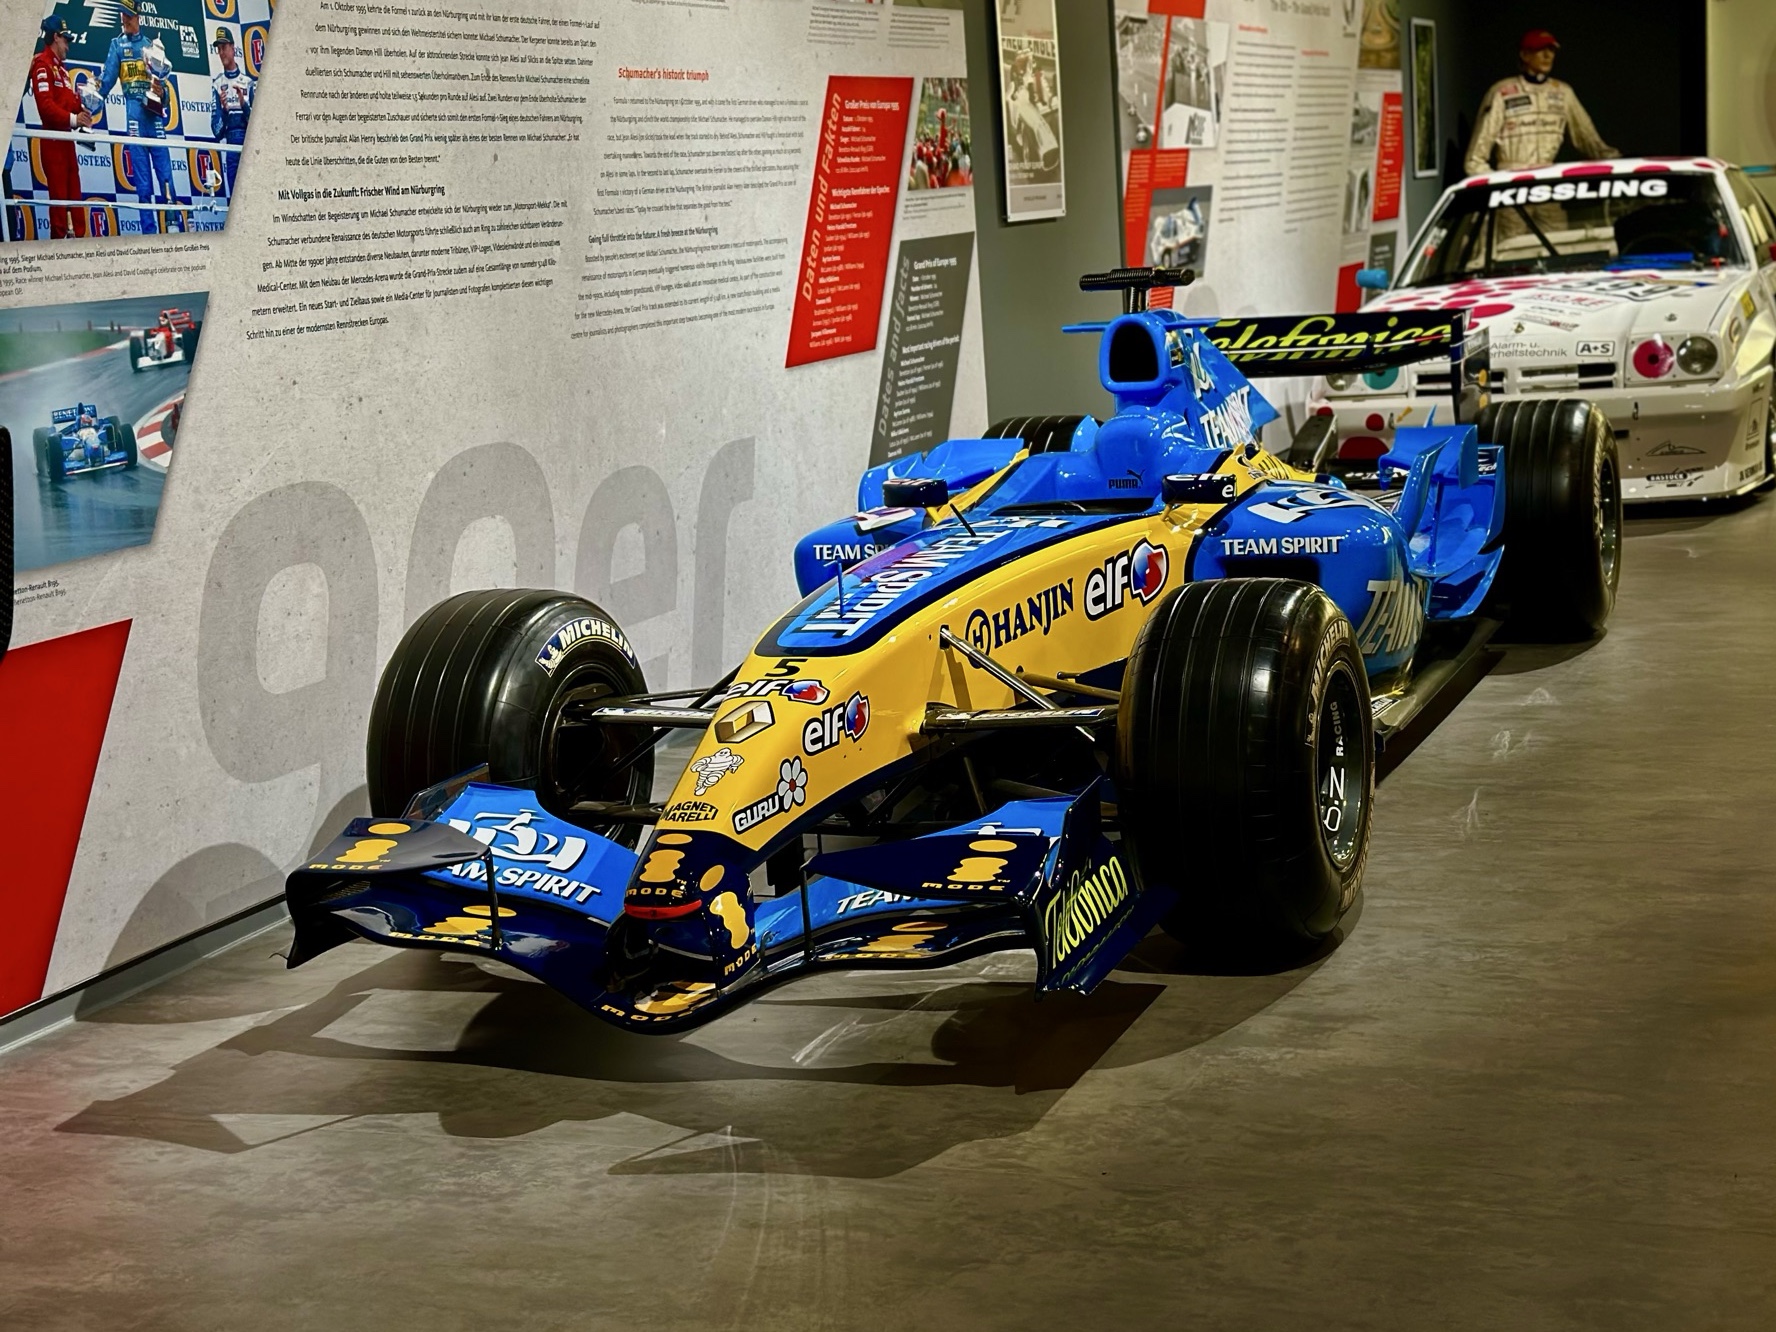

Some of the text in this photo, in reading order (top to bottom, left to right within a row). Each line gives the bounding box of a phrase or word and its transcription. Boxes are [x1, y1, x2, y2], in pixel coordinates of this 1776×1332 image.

[139, 15, 179, 30] BURGRING
[106, 94, 126, 105] FOST
[78, 153, 111, 167] OSTER'S
[172, 160, 187, 171] ER'S
[291, 189, 314, 201] Vollgas
[333, 187, 360, 198] Zukunft:
[360, 186, 384, 197] Frischer
[385, 185, 400, 196] Wind
[411, 184, 445, 196] Nürburgring
[802, 93, 842, 301] Daten und Fakten
[1488, 179, 1668, 208] KISSLING
[121, 219, 141, 231] FOST
[196, 221, 224, 231] FOSTER
[1489, 347, 1568, 358] erheitstechnik
[1490, 341, 1527, 350] Alarm-
[1580, 343, 1611, 354] A+S
[1109, 478, 1140, 489] PUMA
[813, 544, 861, 560] TEAM
[1221, 536, 1341, 555] TEAM SPIRIT
[1086, 556, 1128, 616] elf
[992, 577, 1074, 649] HANJIN
[558, 619, 634, 659] MICHELIN
[764, 658, 808, 677] 5
[724, 679, 792, 700] elf
[804, 706, 846, 754] elf
[1332, 701, 1344, 757] RACING
[733, 794, 780, 832] GURU
[497, 868, 601, 902] SPIRIT
